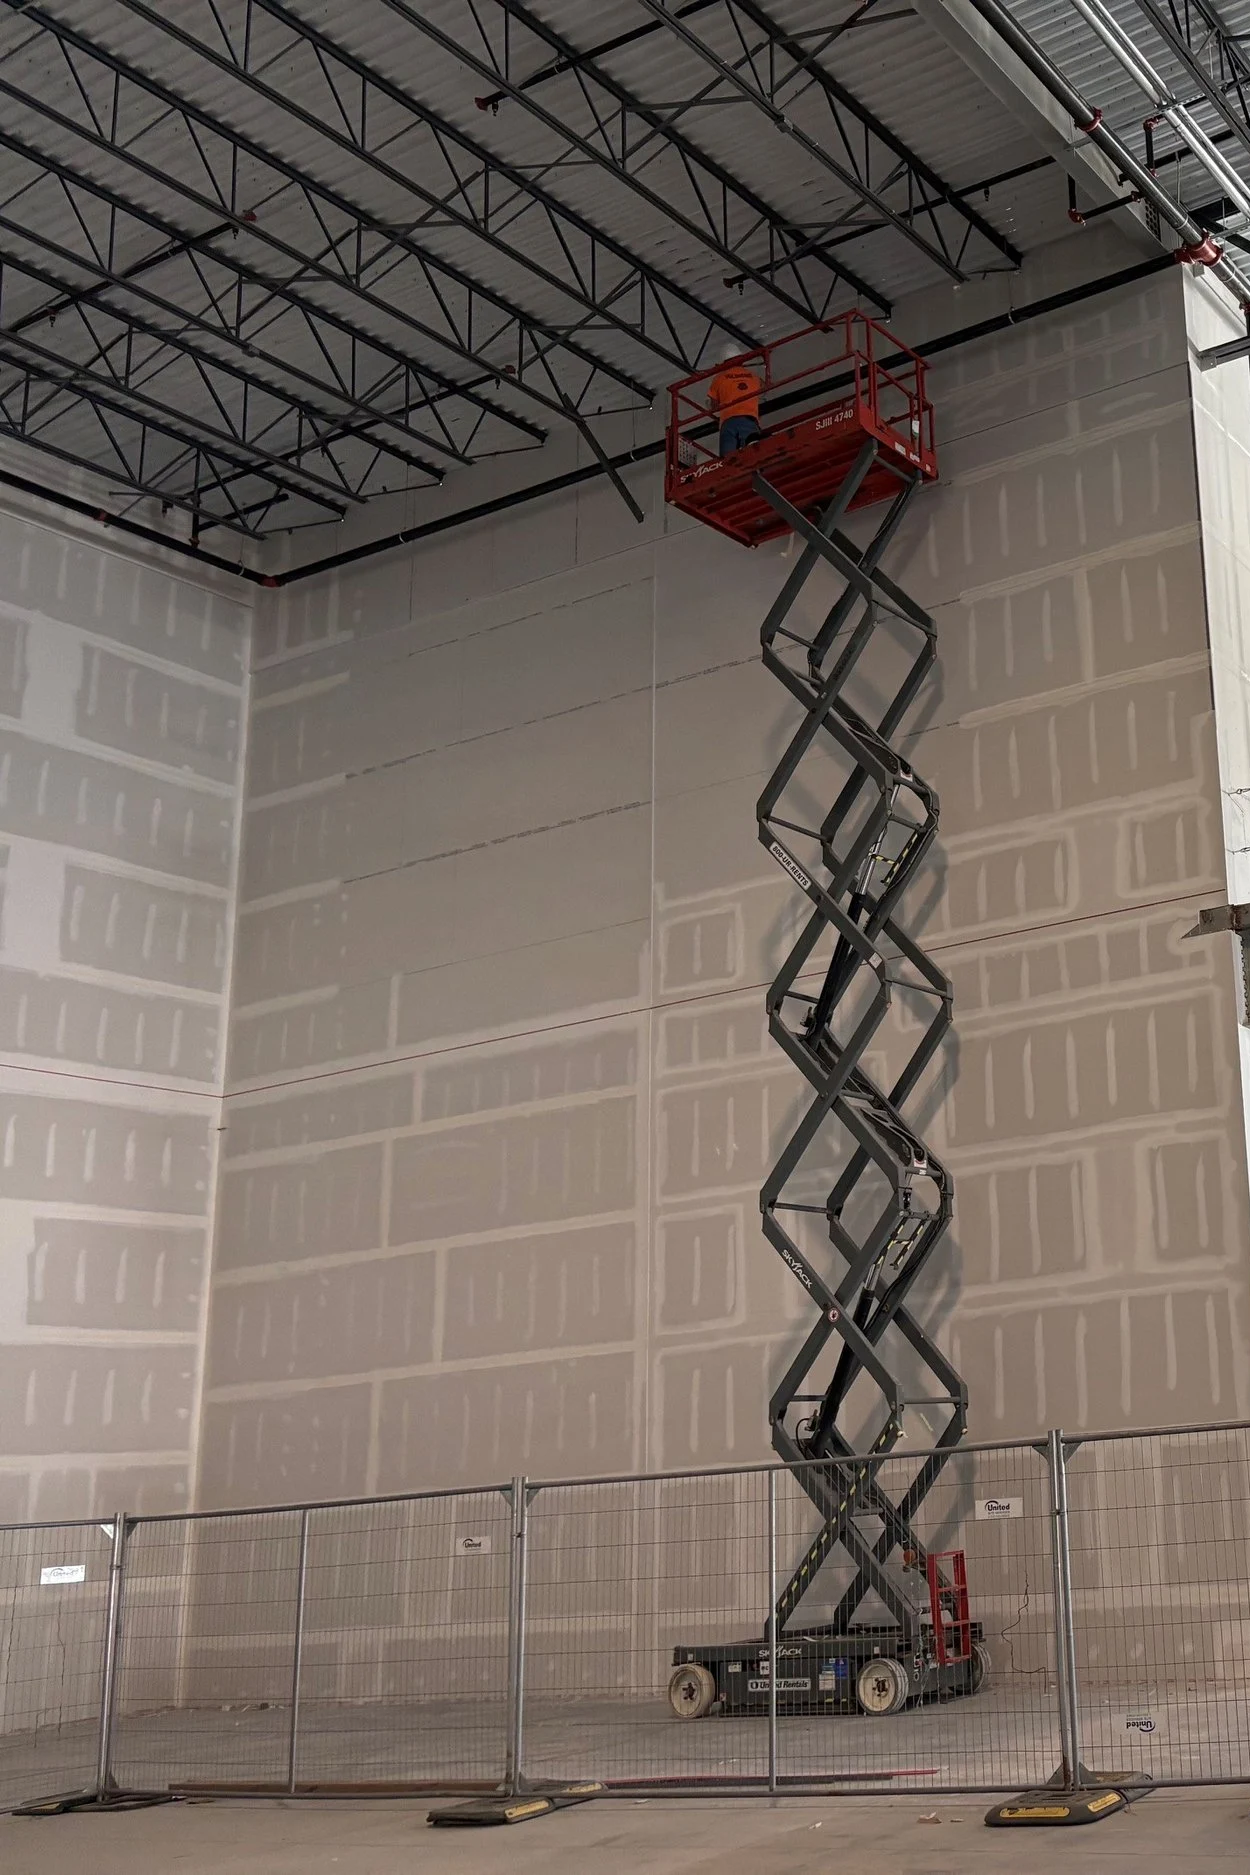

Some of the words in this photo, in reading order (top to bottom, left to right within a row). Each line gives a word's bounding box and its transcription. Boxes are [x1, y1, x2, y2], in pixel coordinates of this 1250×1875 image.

[834, 409, 854, 423] 4740
[772, 845, 809, 887] 800-UR-RENTS
[782, 1249, 813, 1289] SKYJACK
[987, 1503, 1011, 1512] United
[783, 1680, 809, 1690] Rentals
[1126, 1720, 1153, 1729] United
